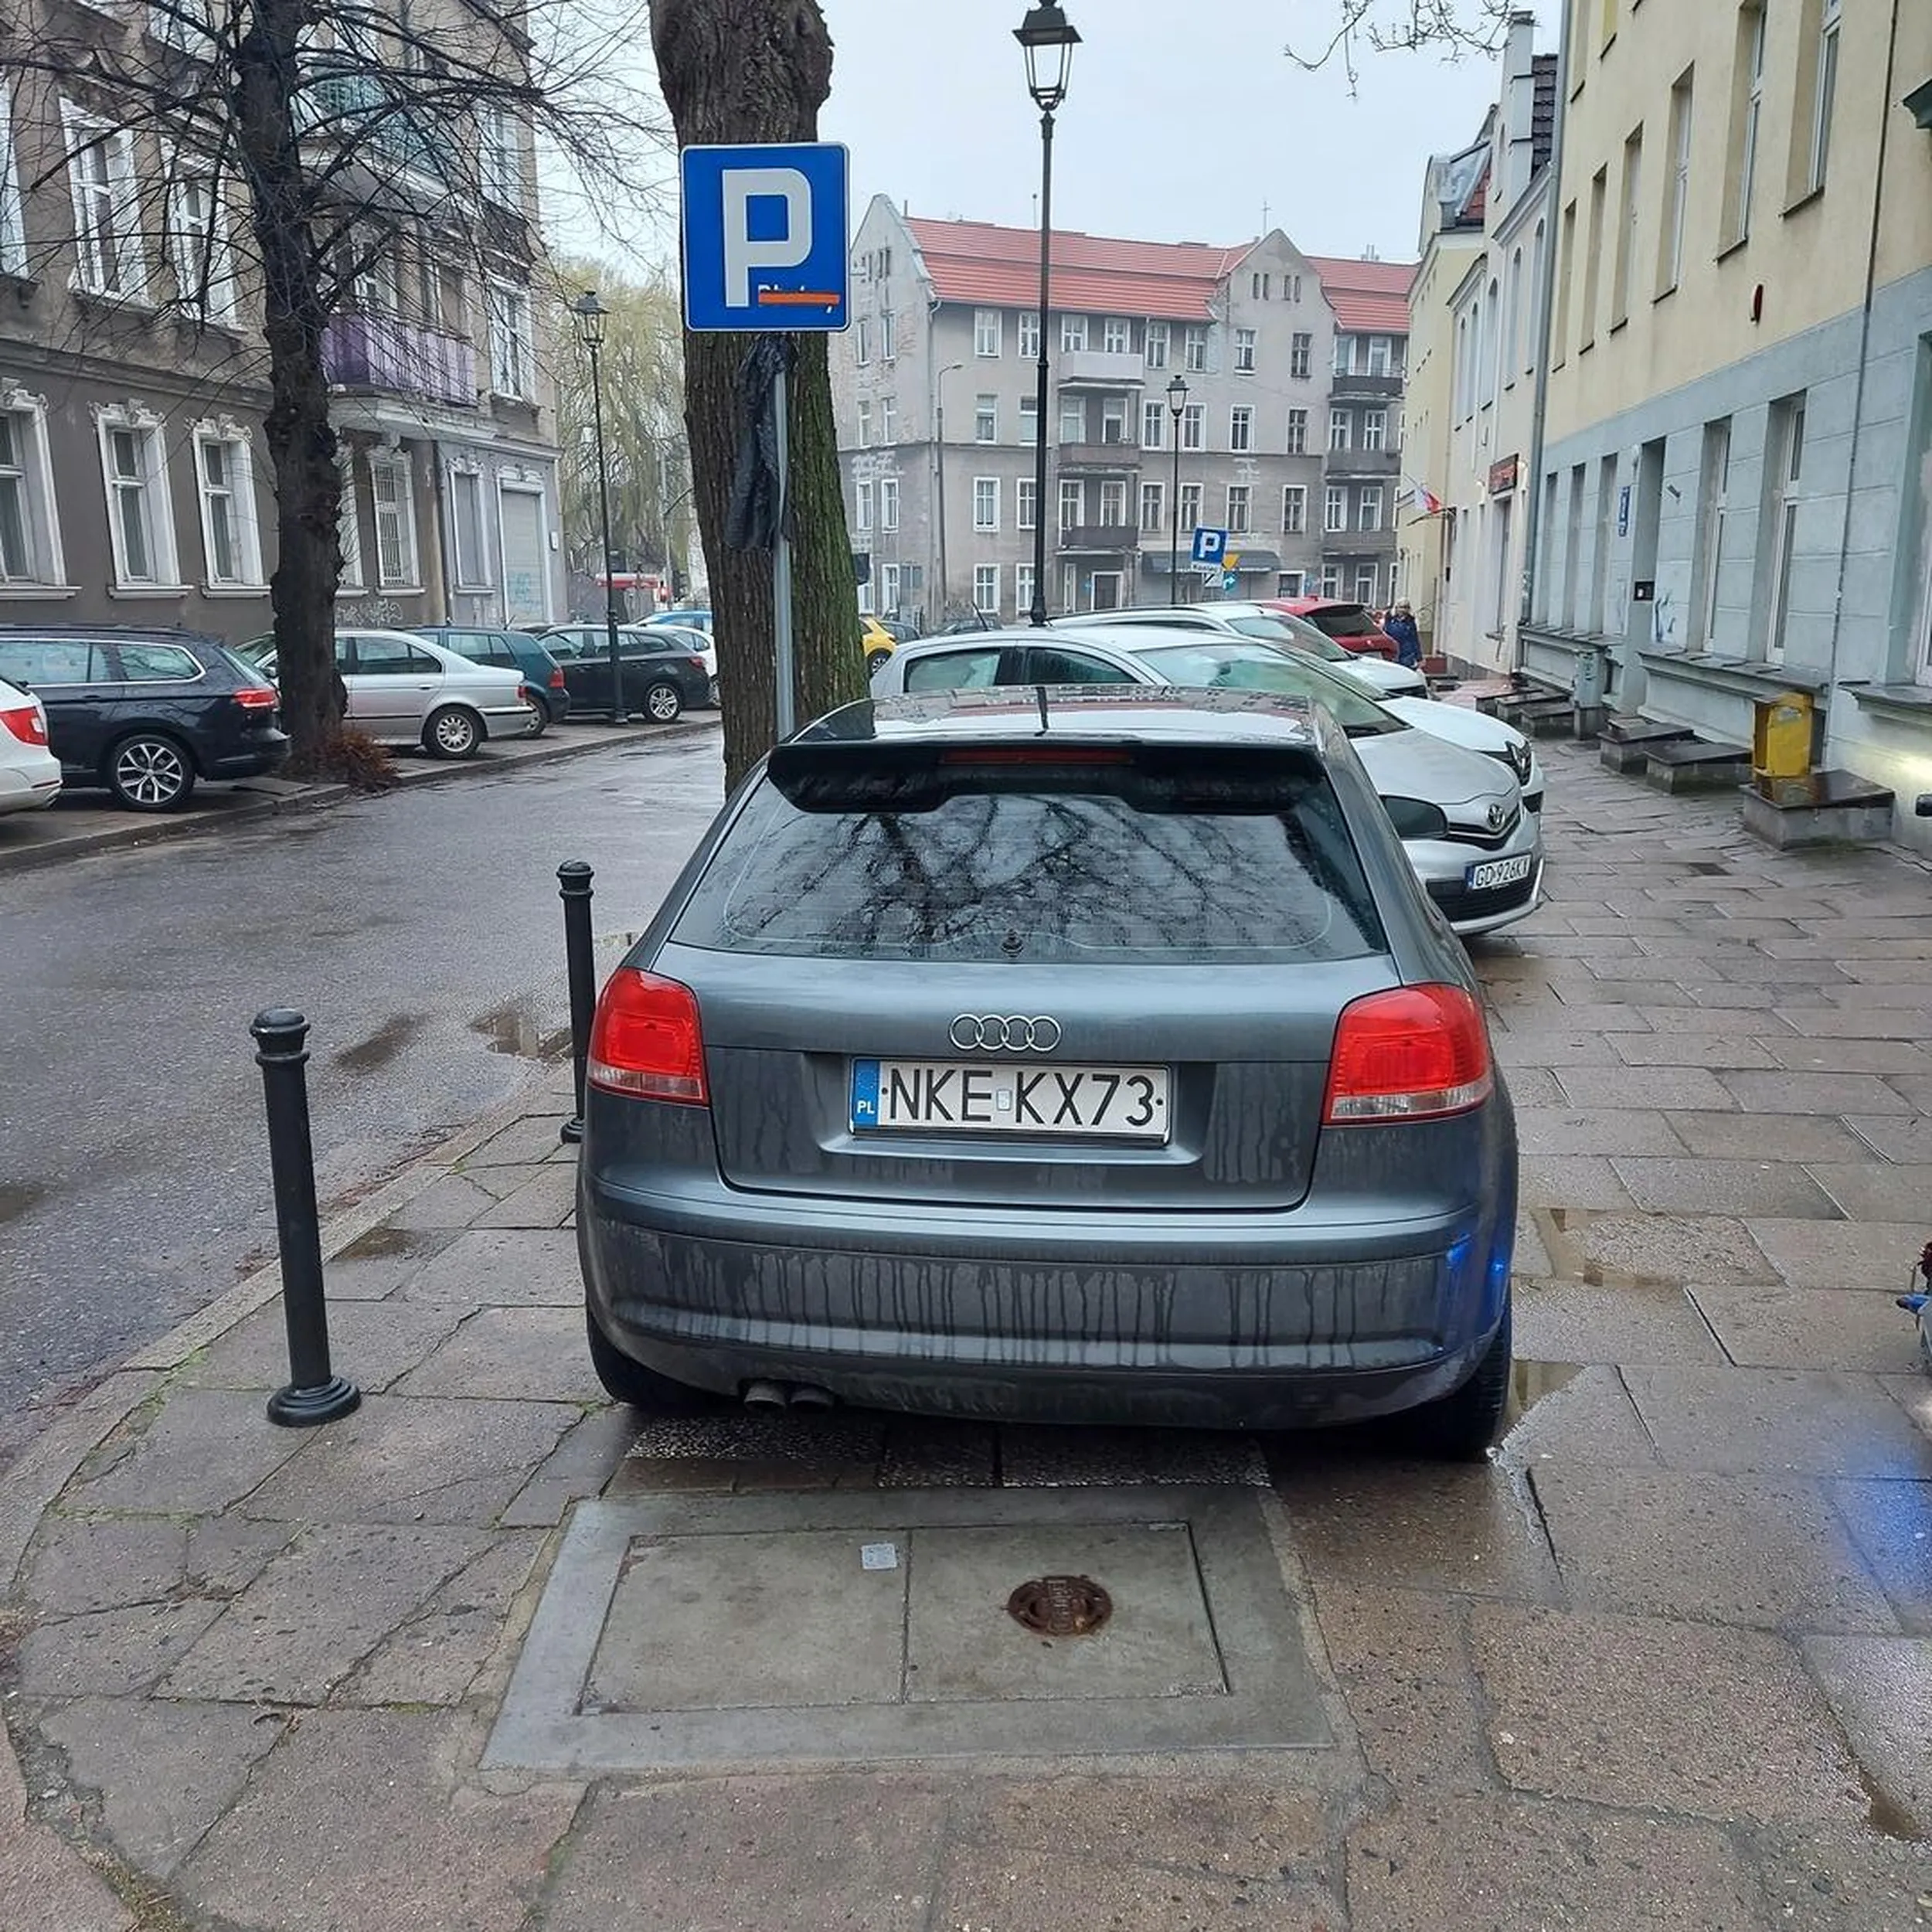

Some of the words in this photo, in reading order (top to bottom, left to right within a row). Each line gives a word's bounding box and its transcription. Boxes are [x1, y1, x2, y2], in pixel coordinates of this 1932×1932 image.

[723, 168, 812, 308] P
[1199, 532, 1220, 558] P
[856, 1100, 875, 1114] PL
[889, 1068, 993, 1122] NKE
[1015, 1070, 1155, 1128] KX73
